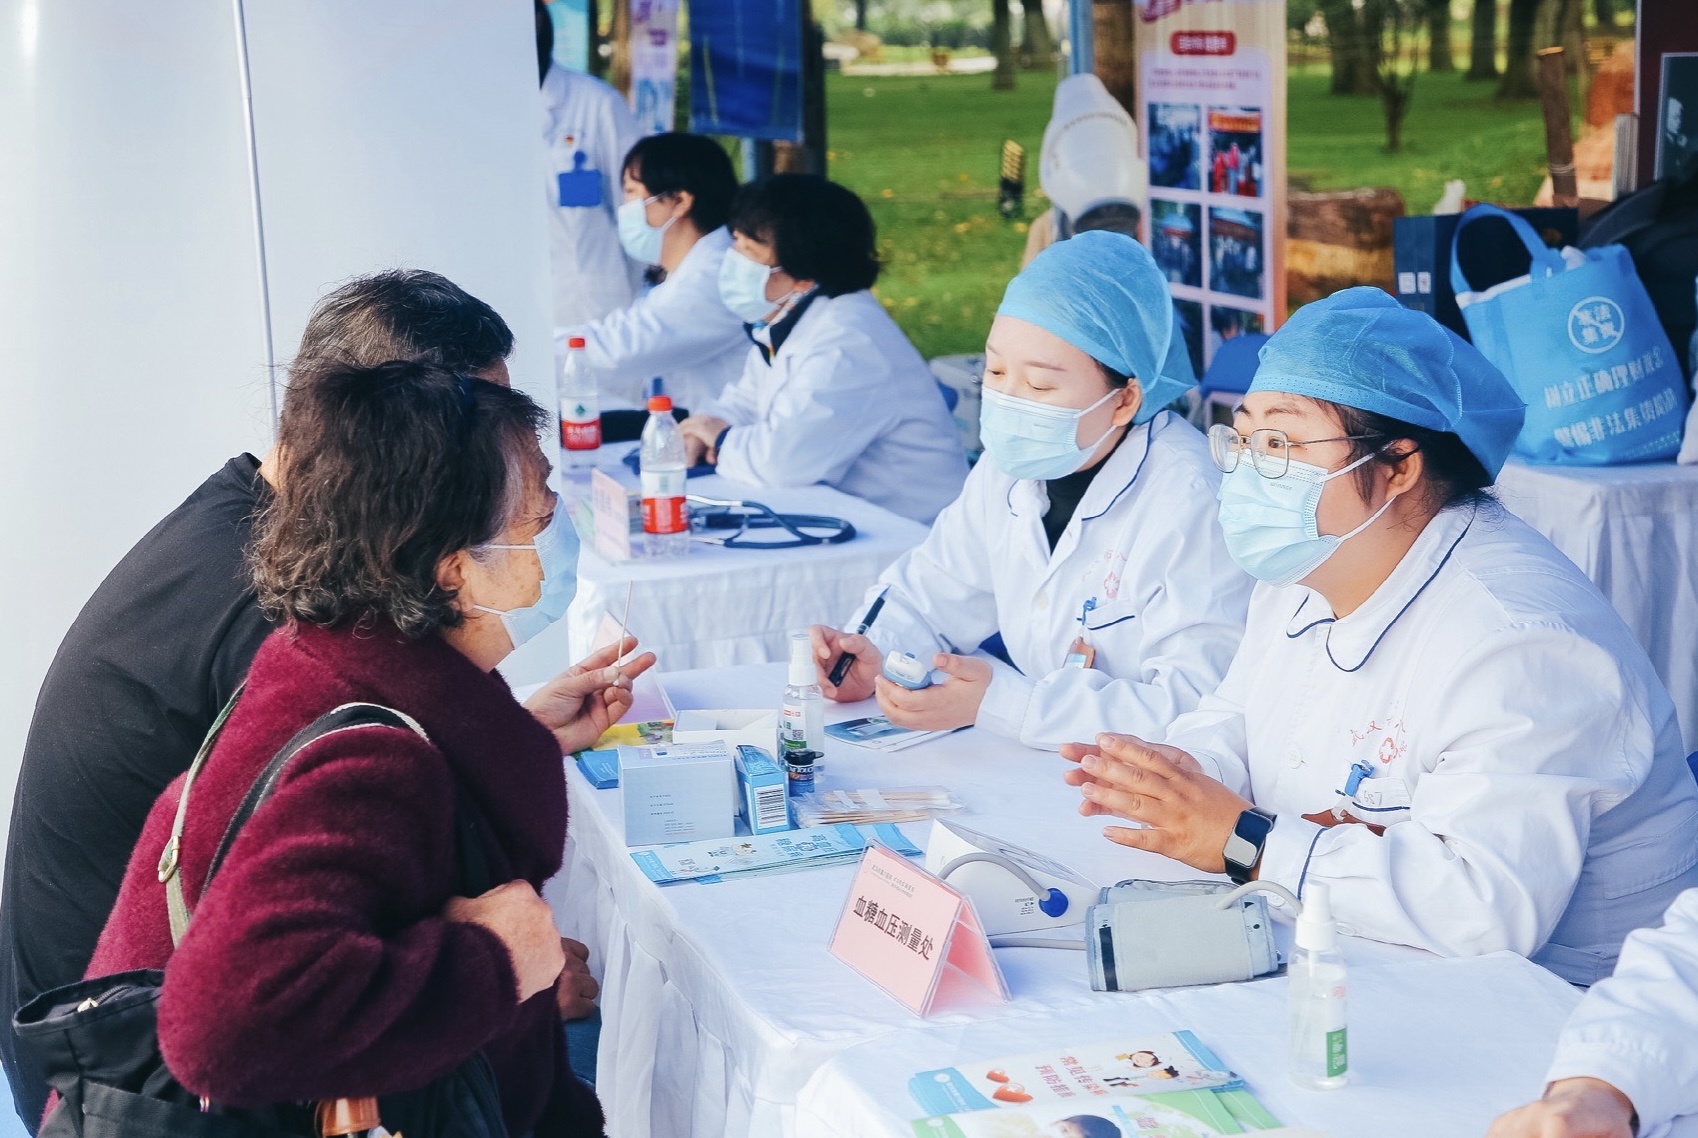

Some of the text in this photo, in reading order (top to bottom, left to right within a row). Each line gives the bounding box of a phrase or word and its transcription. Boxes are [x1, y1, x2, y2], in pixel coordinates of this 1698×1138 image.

[853, 896, 933, 960] 血糖血压测量处
